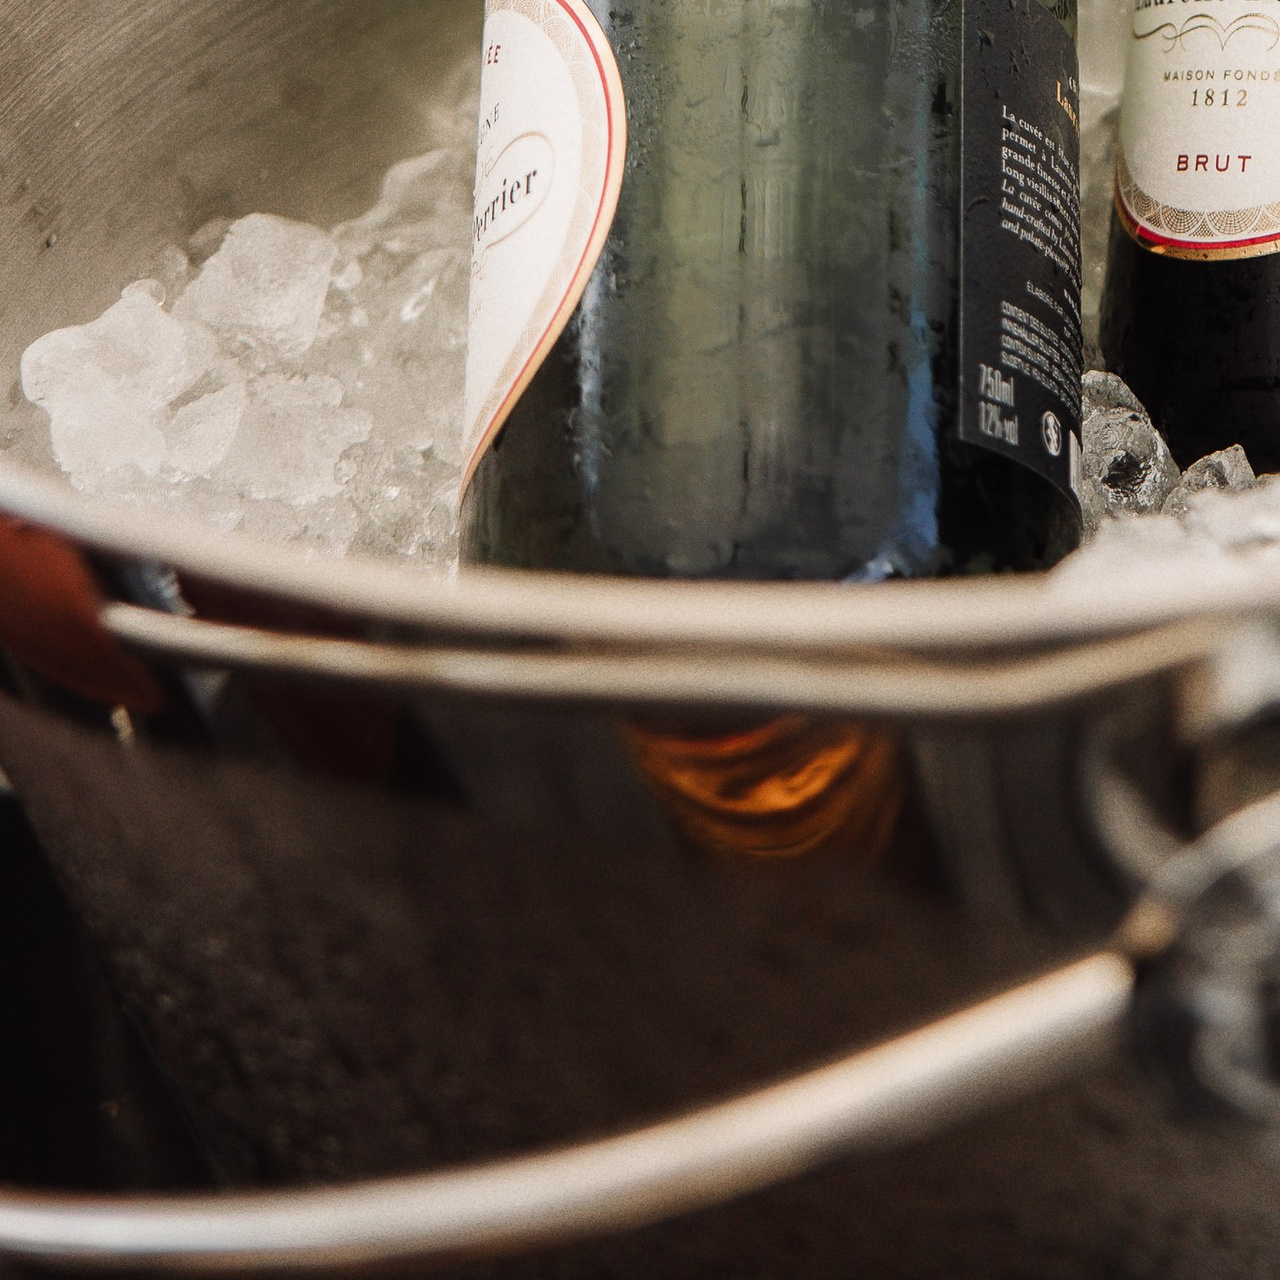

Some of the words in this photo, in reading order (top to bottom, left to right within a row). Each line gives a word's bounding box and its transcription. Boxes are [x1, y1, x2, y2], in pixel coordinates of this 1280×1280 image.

[1163, 69, 1216, 82] MAISON
[1190, 87, 1249, 108] 1812
[1002, 104, 1016, 122] La
[1019, 118, 1043, 141] cuvée
[1002, 127, 1037, 155] permet
[1001, 145, 1036, 171] grande
[1176, 153, 1252, 173] BRUT
[1001, 159, 1025, 187] long
[1001, 178, 1016, 195] La
[1019, 191, 1042, 212] cuvée
[1001, 219, 1020, 234] and
